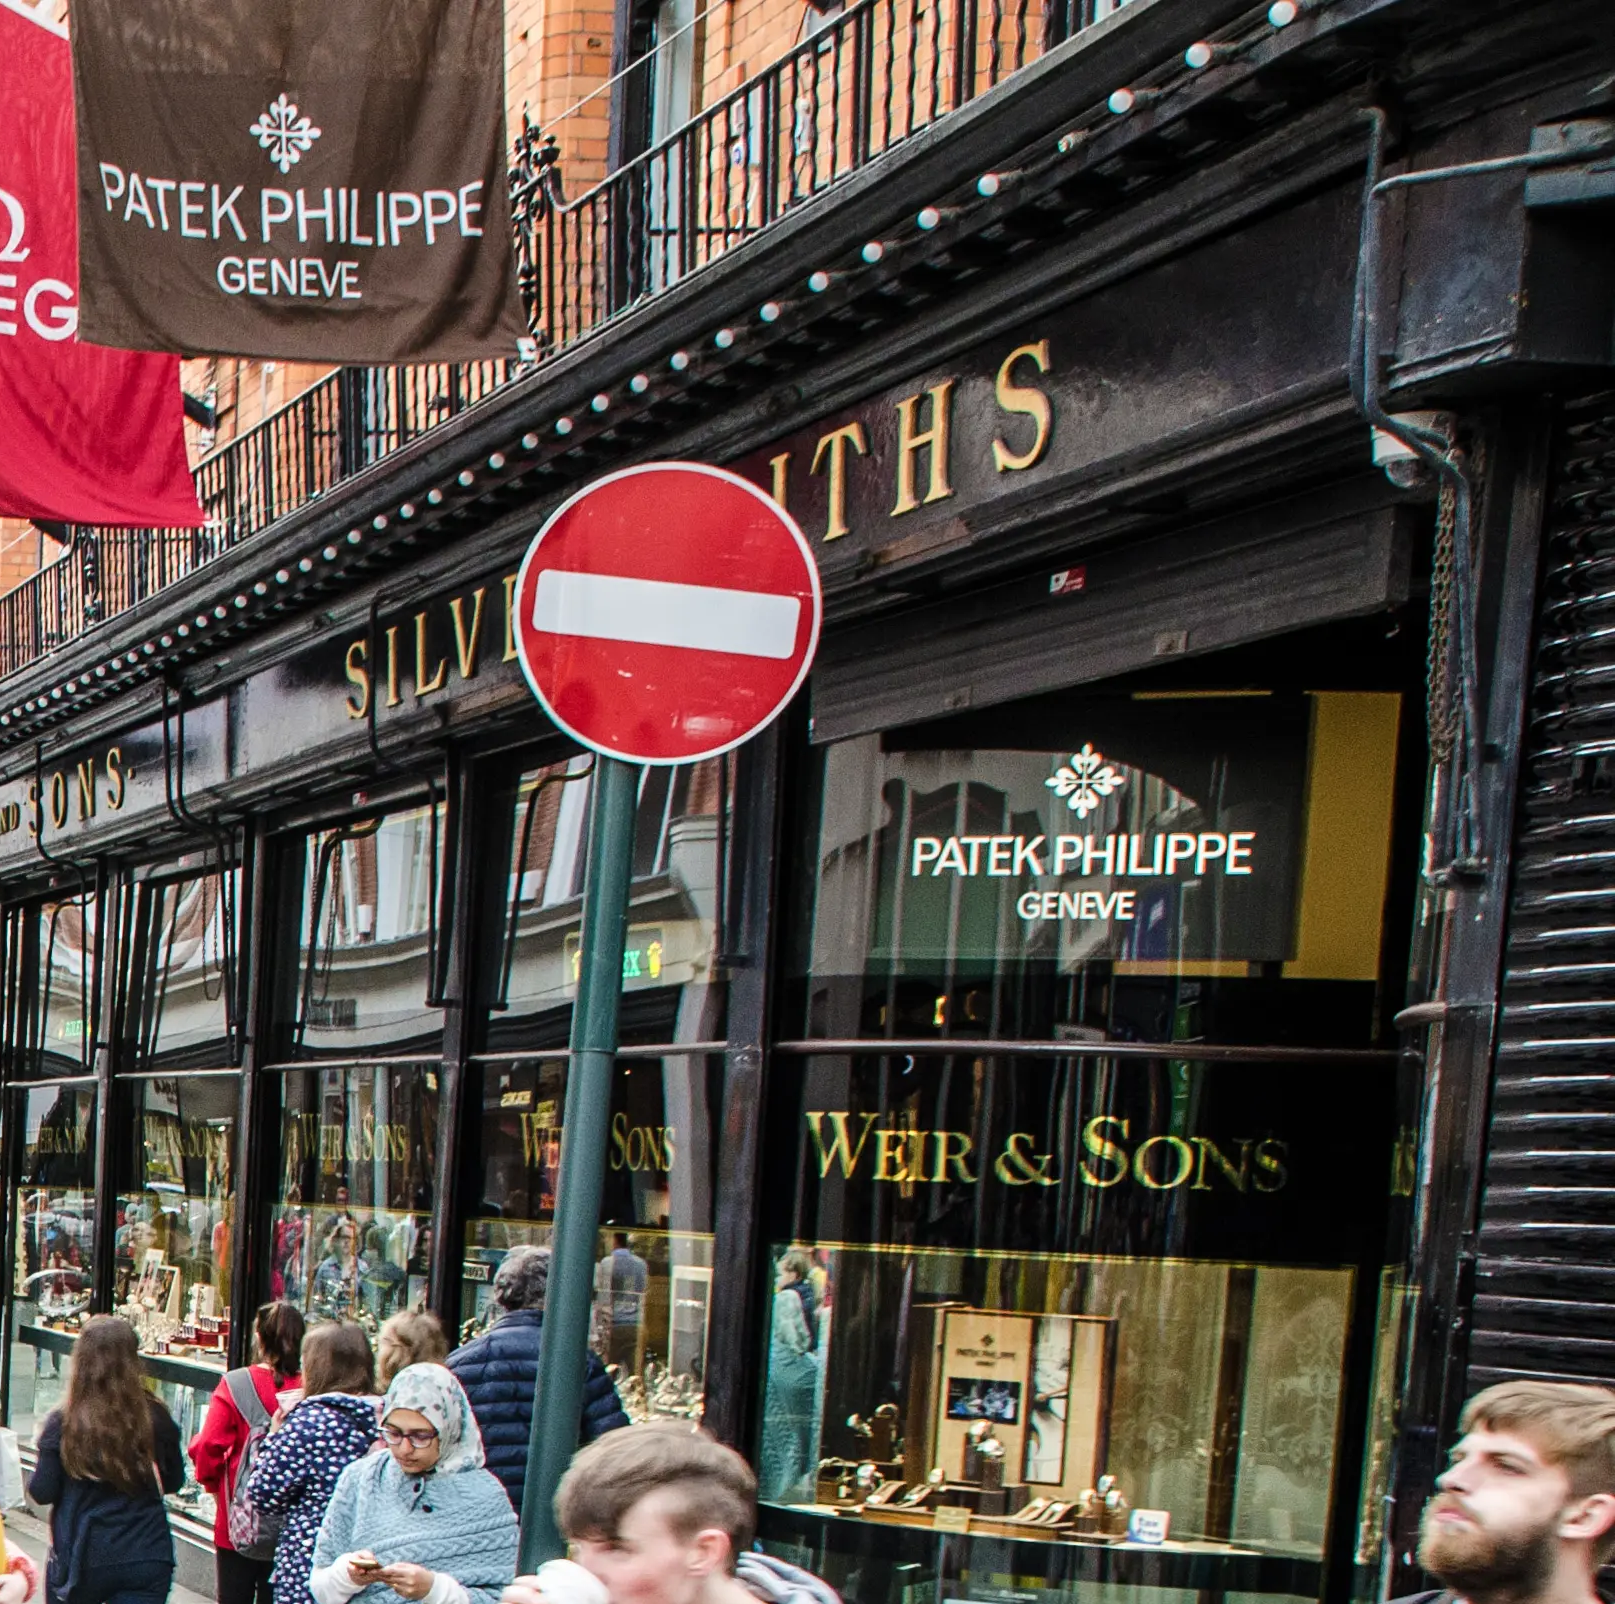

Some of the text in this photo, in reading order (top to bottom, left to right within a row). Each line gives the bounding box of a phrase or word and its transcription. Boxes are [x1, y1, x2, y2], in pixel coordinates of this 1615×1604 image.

[98, 161, 484, 248] PATEK PHILIPPE
[216, 255, 363, 299] GENEVE
[912, 831, 1256, 877] PATEK PHILIPPE
[1016, 890, 1137, 921] GENEVE
[301, 1113, 342, 1160] WEIR
[361, 1112, 407, 1162] SONS
[609, 1111, 677, 1172] SONS
[805, 1111, 1289, 1194] WEIR & SONS
